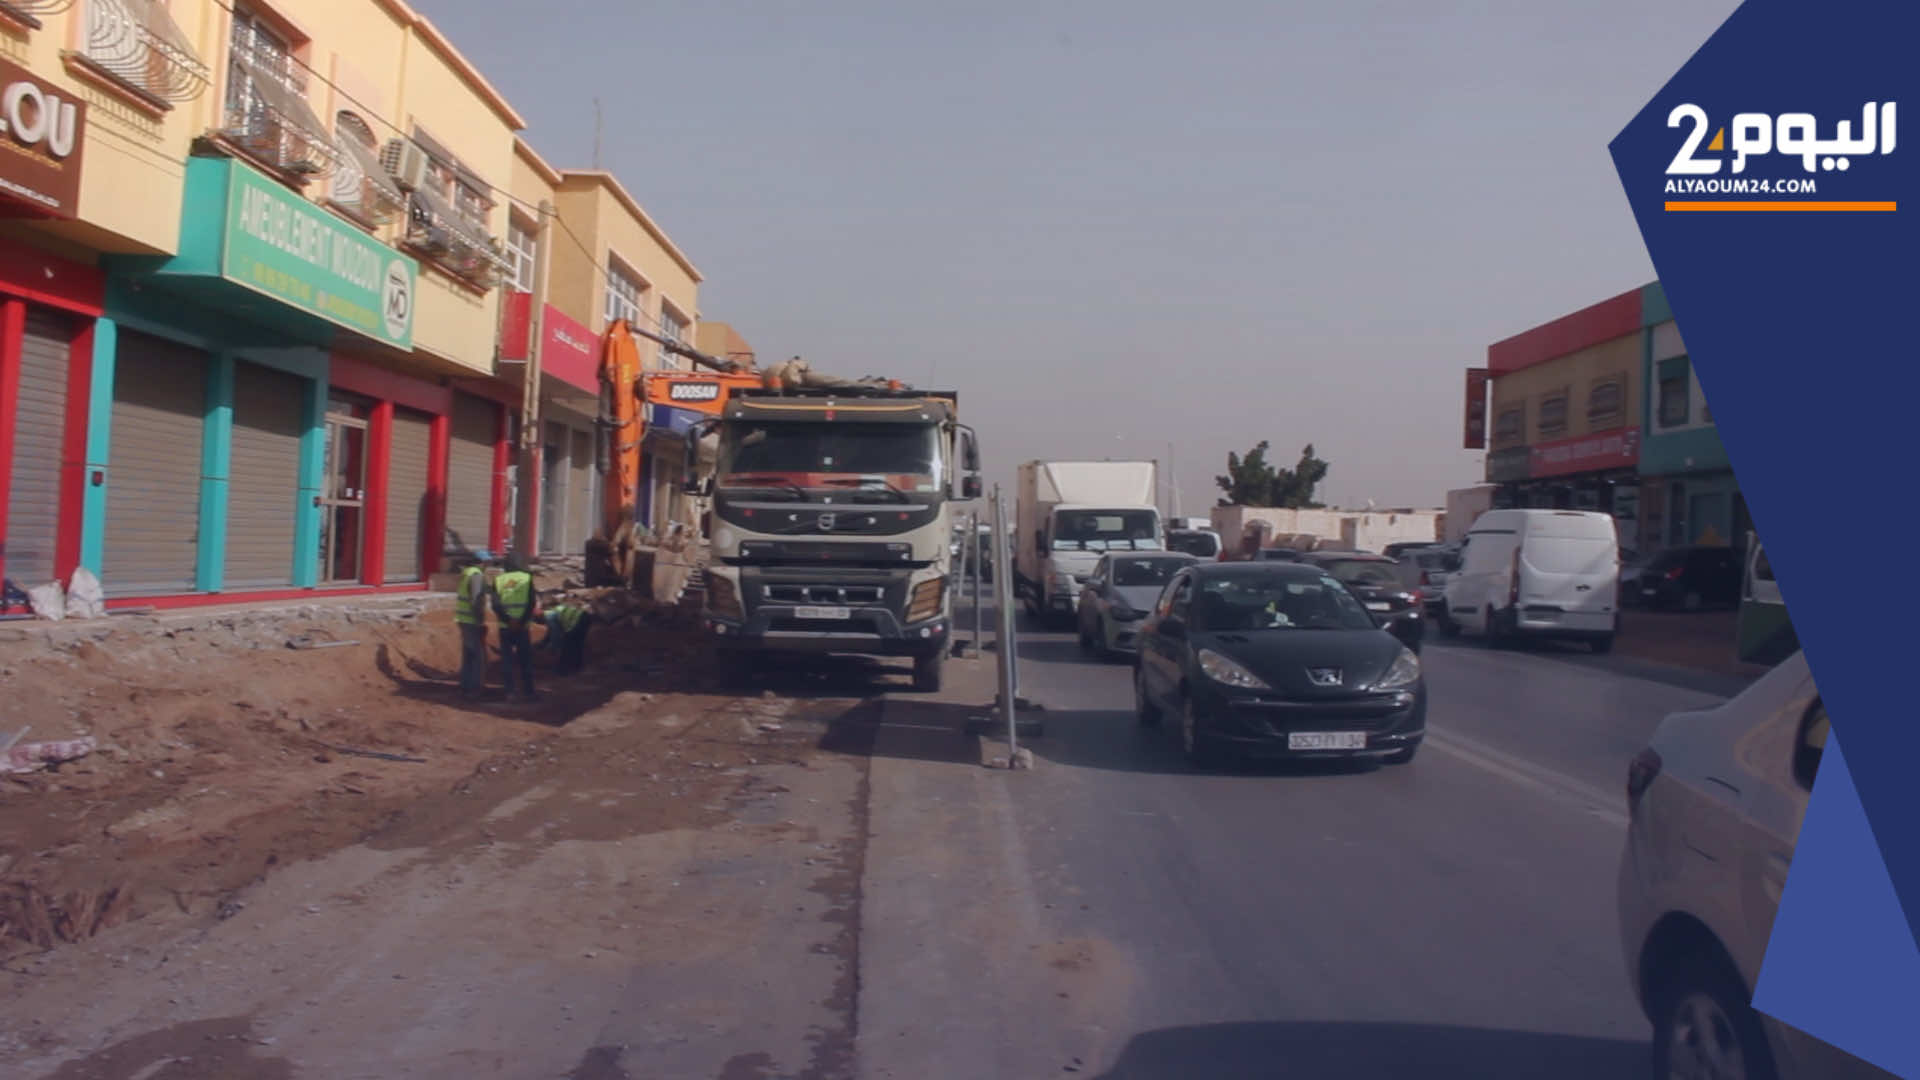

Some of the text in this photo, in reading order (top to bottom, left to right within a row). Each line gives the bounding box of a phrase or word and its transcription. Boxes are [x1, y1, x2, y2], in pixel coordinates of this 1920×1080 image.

[0, 82, 76, 157] OU
[239, 184, 330, 269] AMEUBLEMENT
[671, 384, 719, 399] DOOSAN
